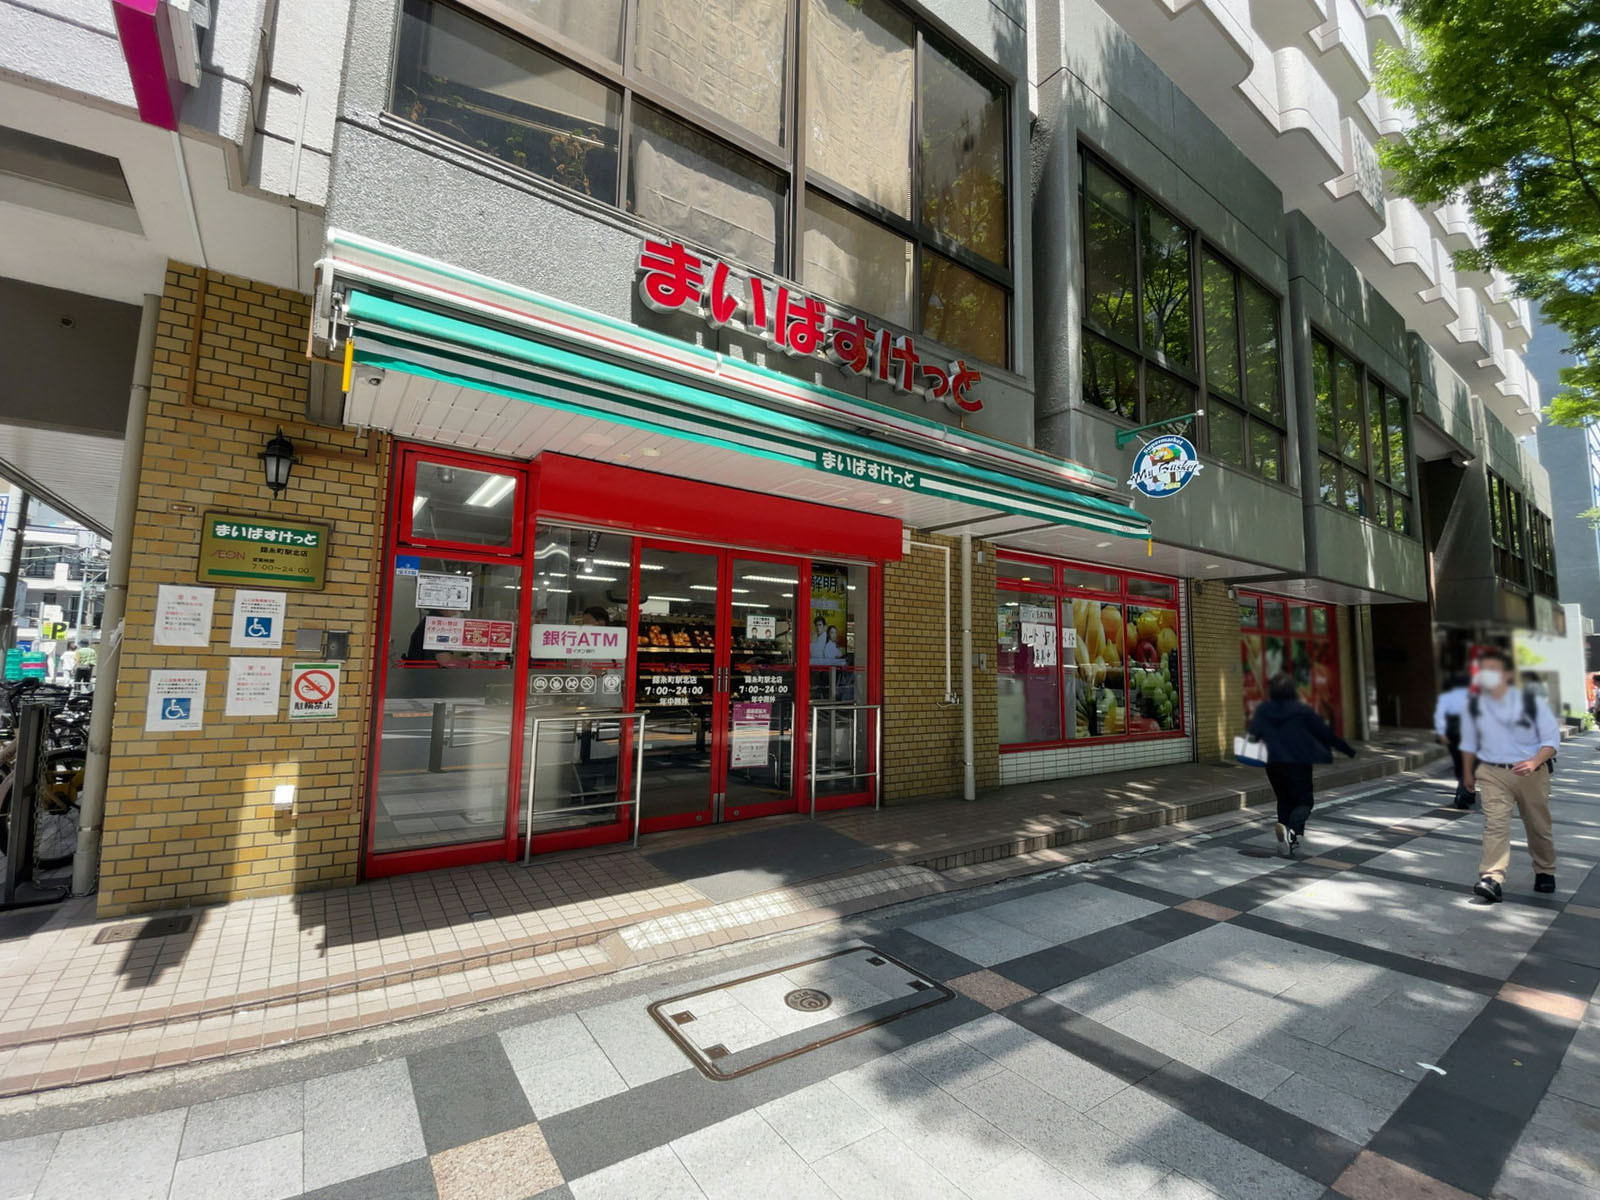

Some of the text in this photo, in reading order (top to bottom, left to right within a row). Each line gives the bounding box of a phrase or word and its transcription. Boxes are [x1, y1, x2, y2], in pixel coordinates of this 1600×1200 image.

[638, 238, 984, 413] まいばすけっと
[821, 451, 915, 488] まいばすけっと
[1130, 460, 1198, 481] My Basket
[215, 524, 317, 546] まいばすけっと
[52, 622, 67, 640] P
[542, 630, 619, 647] 銀行ATM
[294, 701, 334, 711] 駐輪禁止
